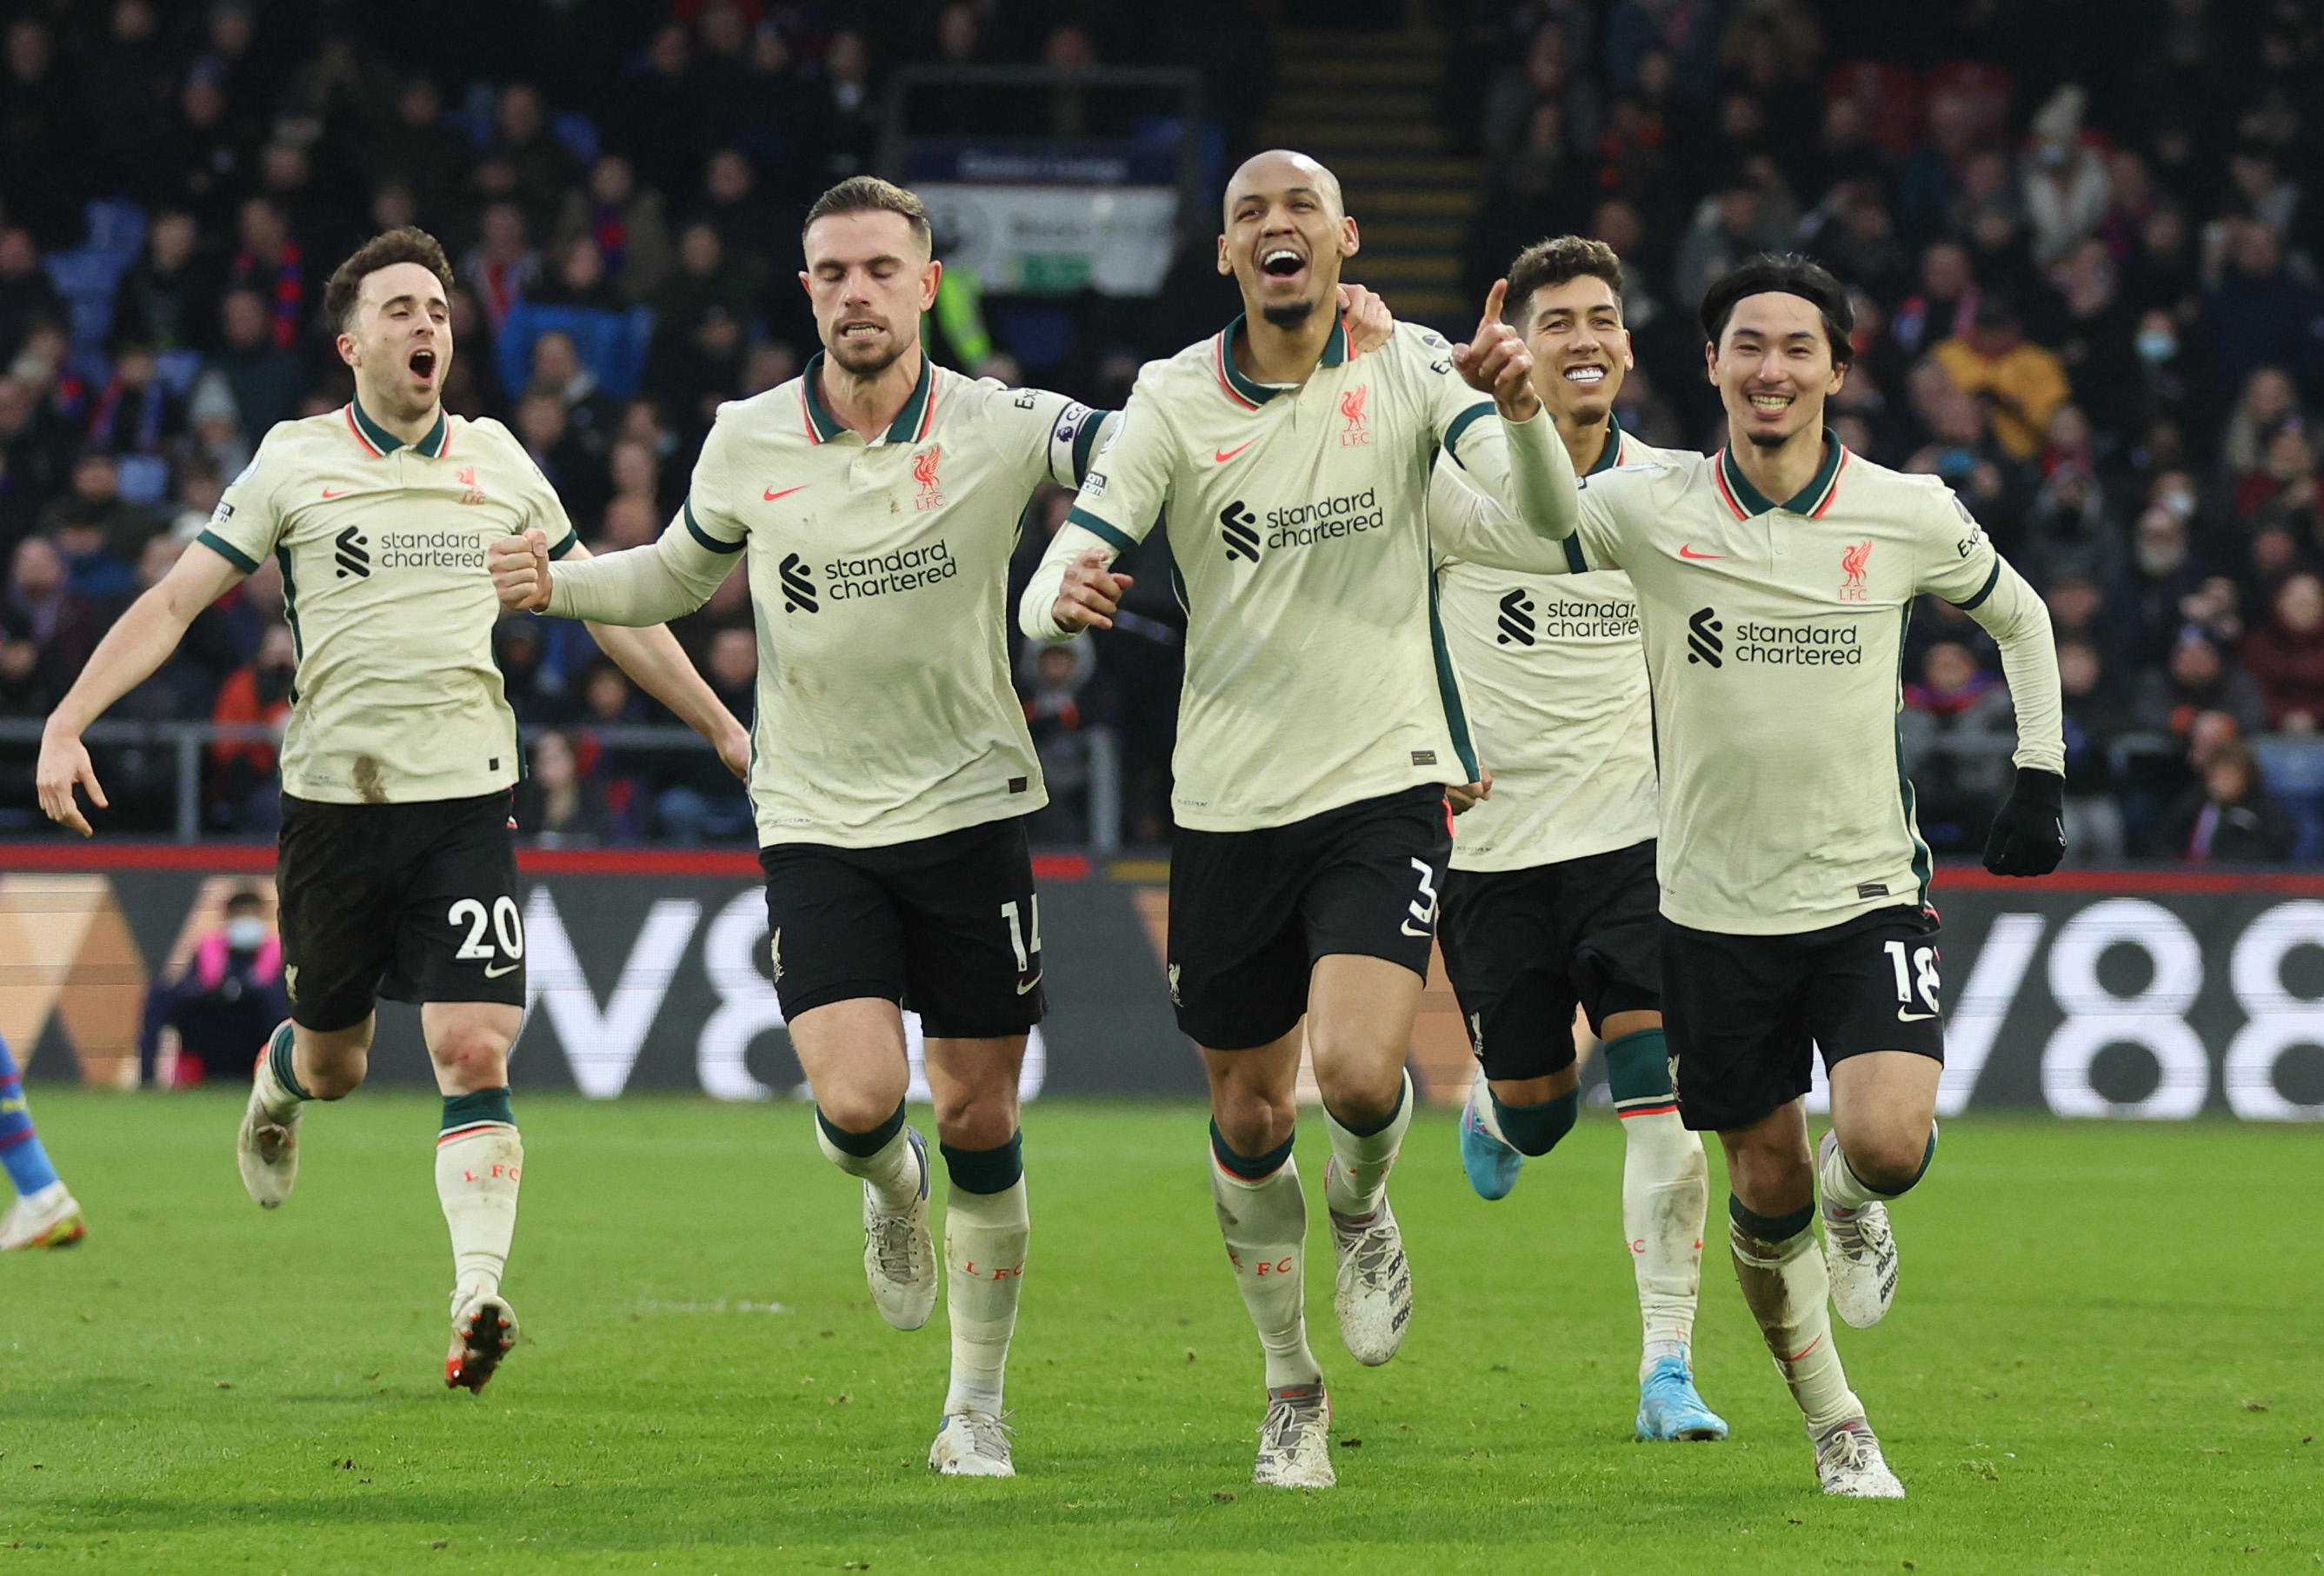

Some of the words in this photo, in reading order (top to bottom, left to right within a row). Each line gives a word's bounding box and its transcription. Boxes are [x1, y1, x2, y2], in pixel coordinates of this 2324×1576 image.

[1342, 431, 1370, 446] LFC
[915, 495, 947, 511] LFC
[1267, 488, 1375, 529] standard
[1267, 507, 1383, 549] chartered
[381, 531, 481, 550] standard
[381, 550, 485, 569] chartered
[824, 539, 949, 580] standard
[829, 557, 957, 600] chartered
[1839, 588, 1868, 601] LFC
[1547, 599, 1636, 618] standar
[1547, 618, 1641, 637] chartere
[1736, 622, 1857, 645] standard
[1735, 644, 1861, 666] chartered
[1408, 856, 1437, 924] 3
[448, 895, 523, 960] 20
[1883, 941, 1941, 1013] 18
